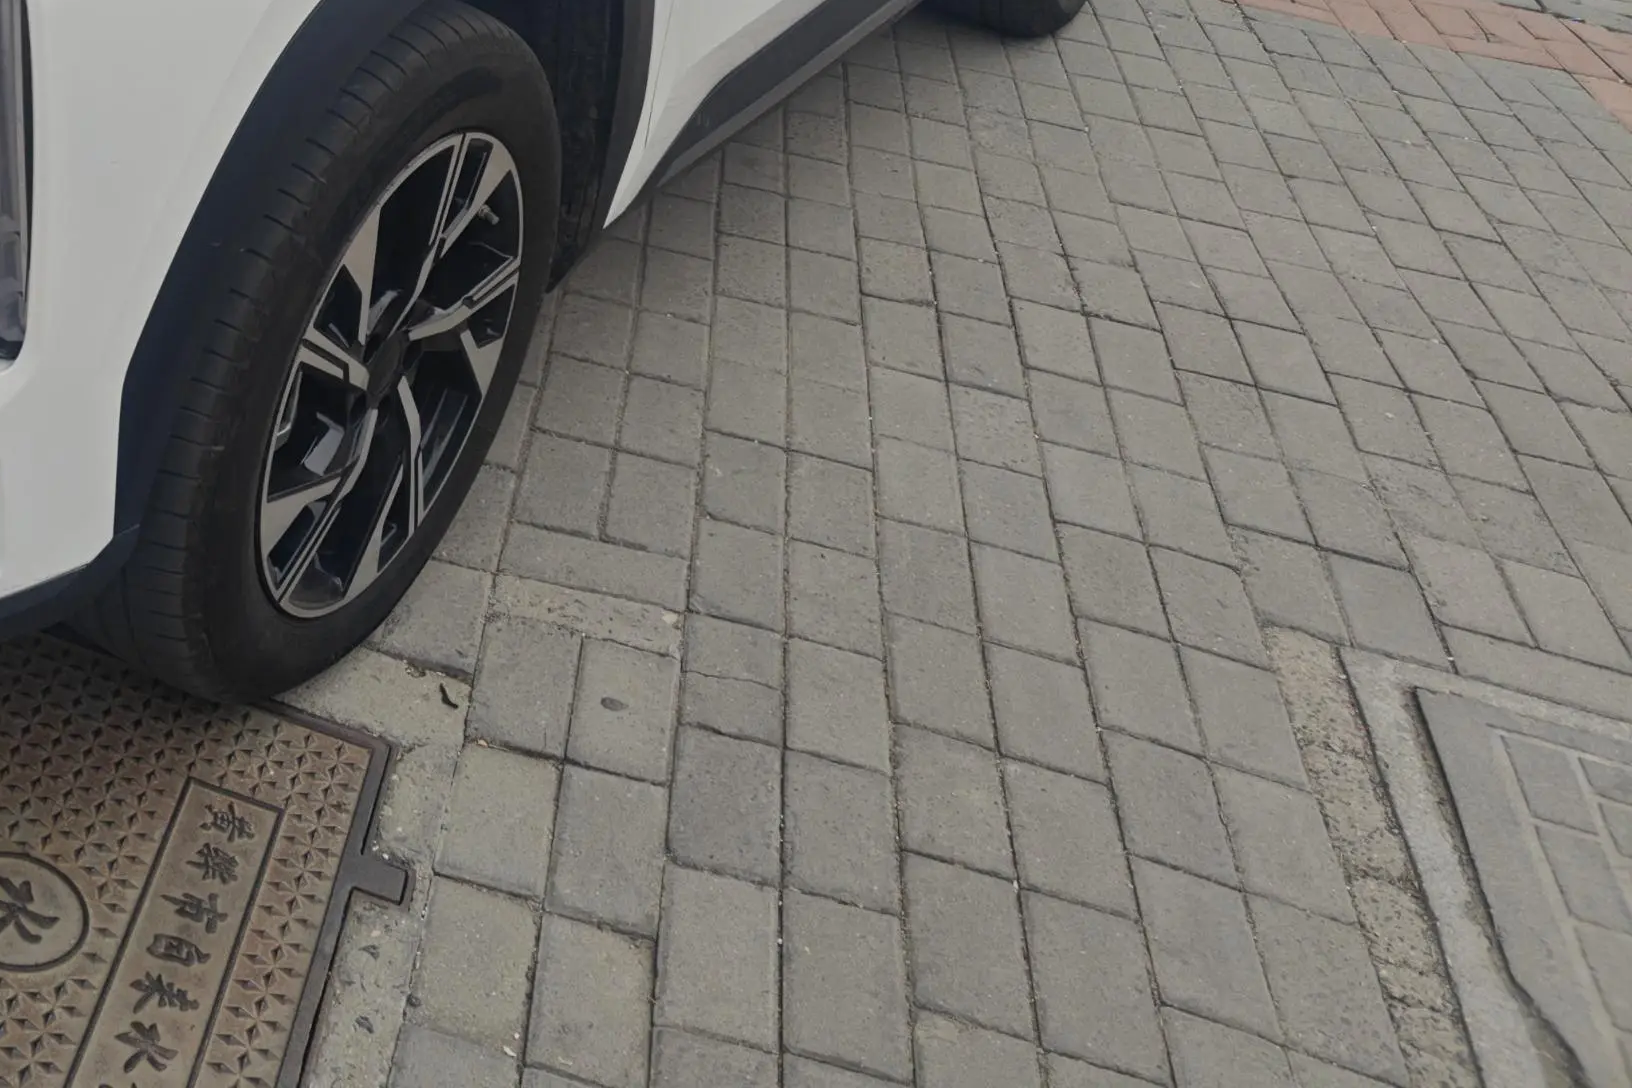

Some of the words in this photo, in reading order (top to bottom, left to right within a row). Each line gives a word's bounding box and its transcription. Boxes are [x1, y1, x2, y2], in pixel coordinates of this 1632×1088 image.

[99, 800, 255, 1088] 黄骅市自来水
